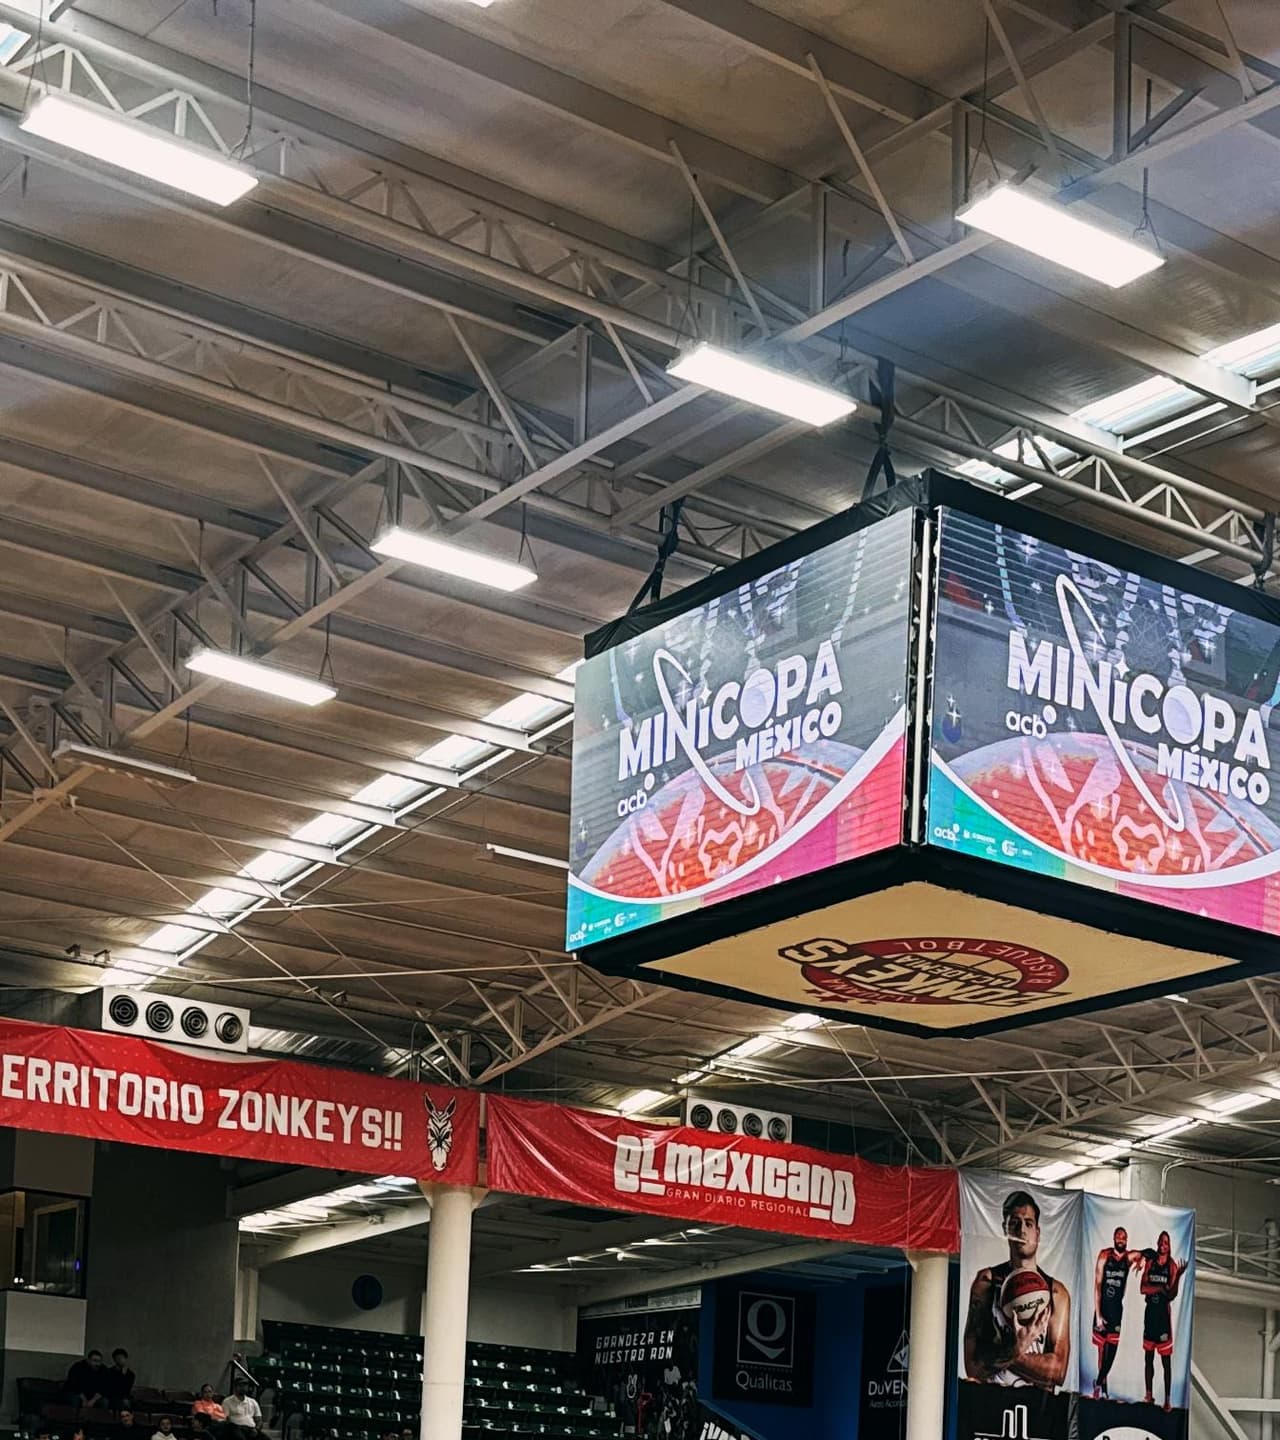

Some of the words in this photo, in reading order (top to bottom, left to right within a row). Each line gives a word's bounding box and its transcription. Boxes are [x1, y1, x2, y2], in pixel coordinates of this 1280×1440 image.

[735, 701, 842, 772] MÉXICO
[1005, 705, 1052, 739] acb
[1157, 742, 1270, 806] MÉXICO
[617, 782, 651, 817] acb
[780, 938, 1072, 1007] ZONKEYS
[217, 1088, 403, 1151] ZONKEYS!!
[666, 1187, 700, 1201] GRAN
[705, 1193, 746, 1208] DIARIO
[751, 1200, 808, 1218] REGIONAL
[595, 1348, 645, 1365] NUESTRO
[596, 1332, 655, 1349] GRANDEZA
[660, 1330, 674, 1343] EN
